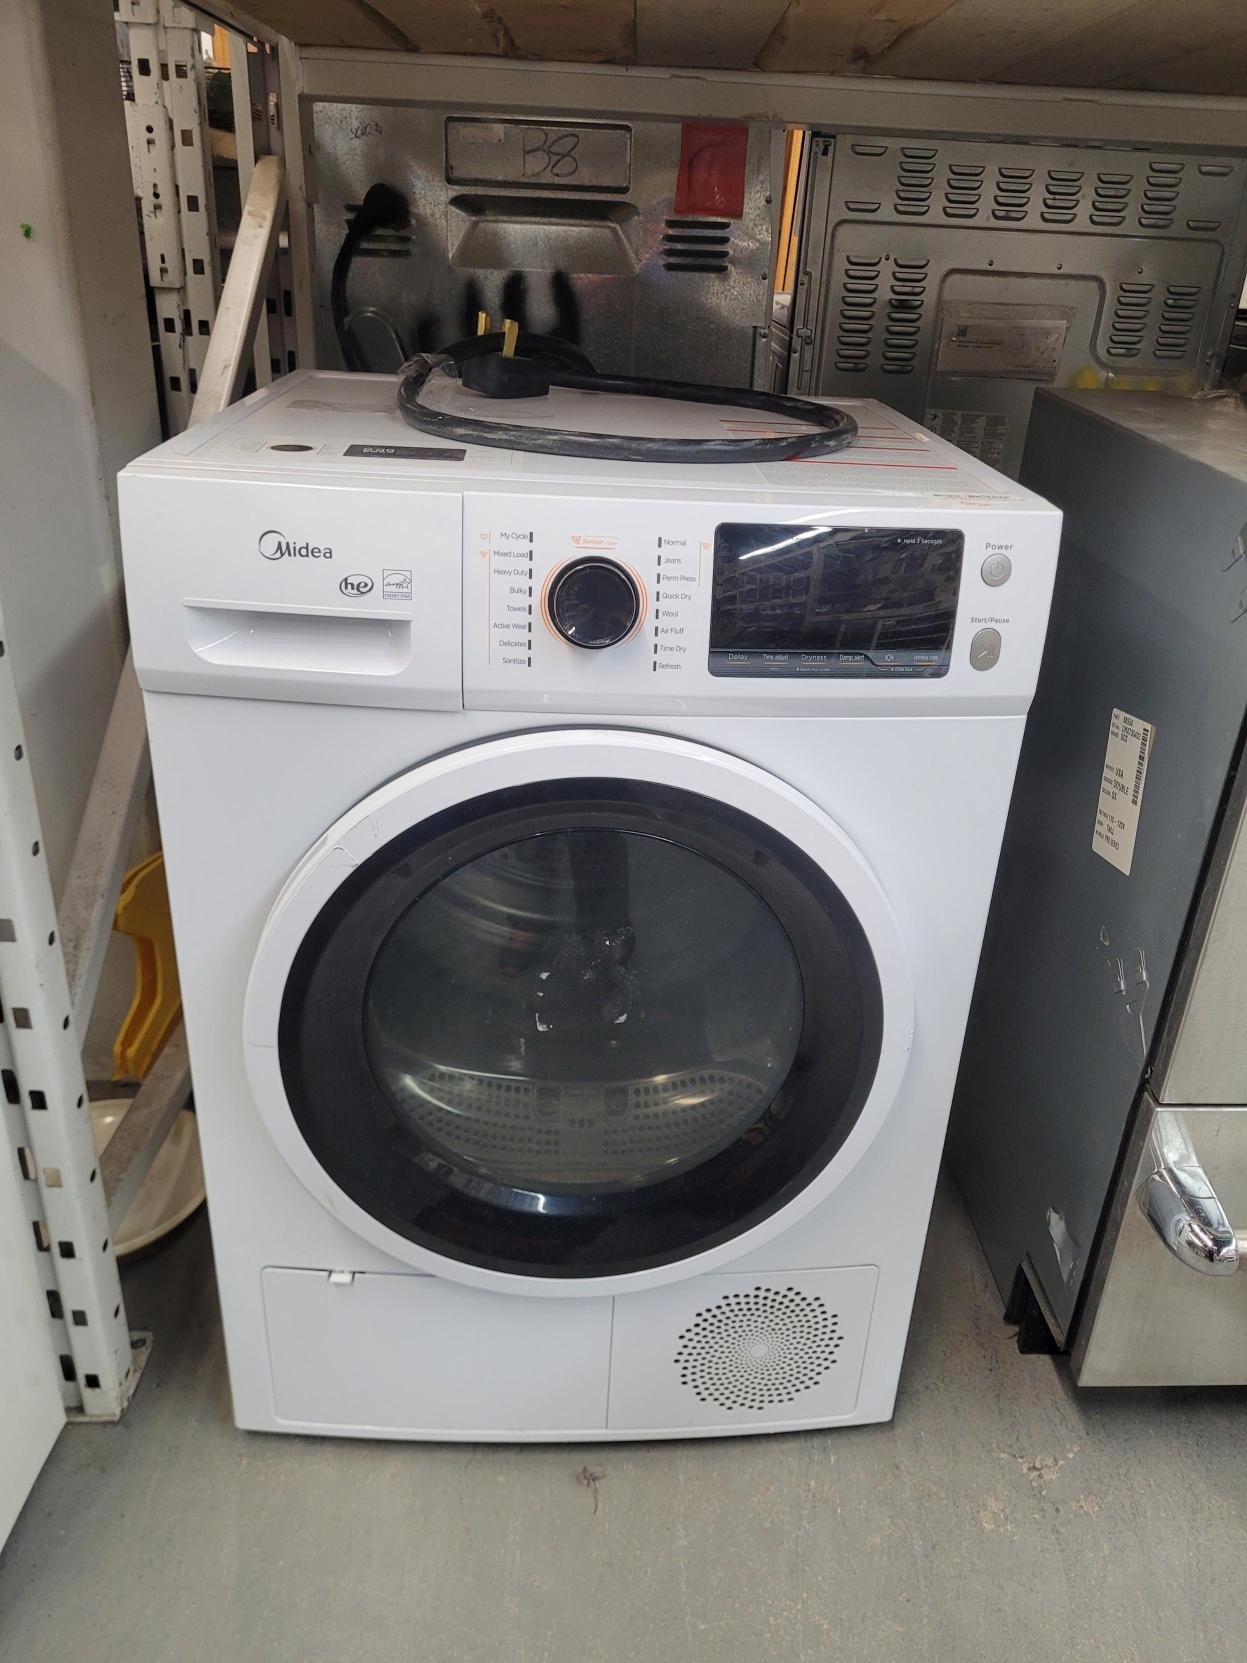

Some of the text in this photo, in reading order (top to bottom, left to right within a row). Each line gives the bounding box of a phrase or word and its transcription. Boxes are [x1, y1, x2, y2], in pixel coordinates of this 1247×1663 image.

[521, 128, 580, 178] B8
[500, 532, 528, 540] My Cycle
[262, 535, 333, 560] Midea
[493, 550, 511, 558] Mixed
[493, 568, 528, 577] Heavy Duty
[344, 576, 369, 594] he
[509, 587, 527, 595] Bulky
[502, 657, 526, 665] Sanitize
[728, 653, 749, 662] Delay
[801, 654, 827, 663] Dryness
[839, 654, 852, 662] Damp
